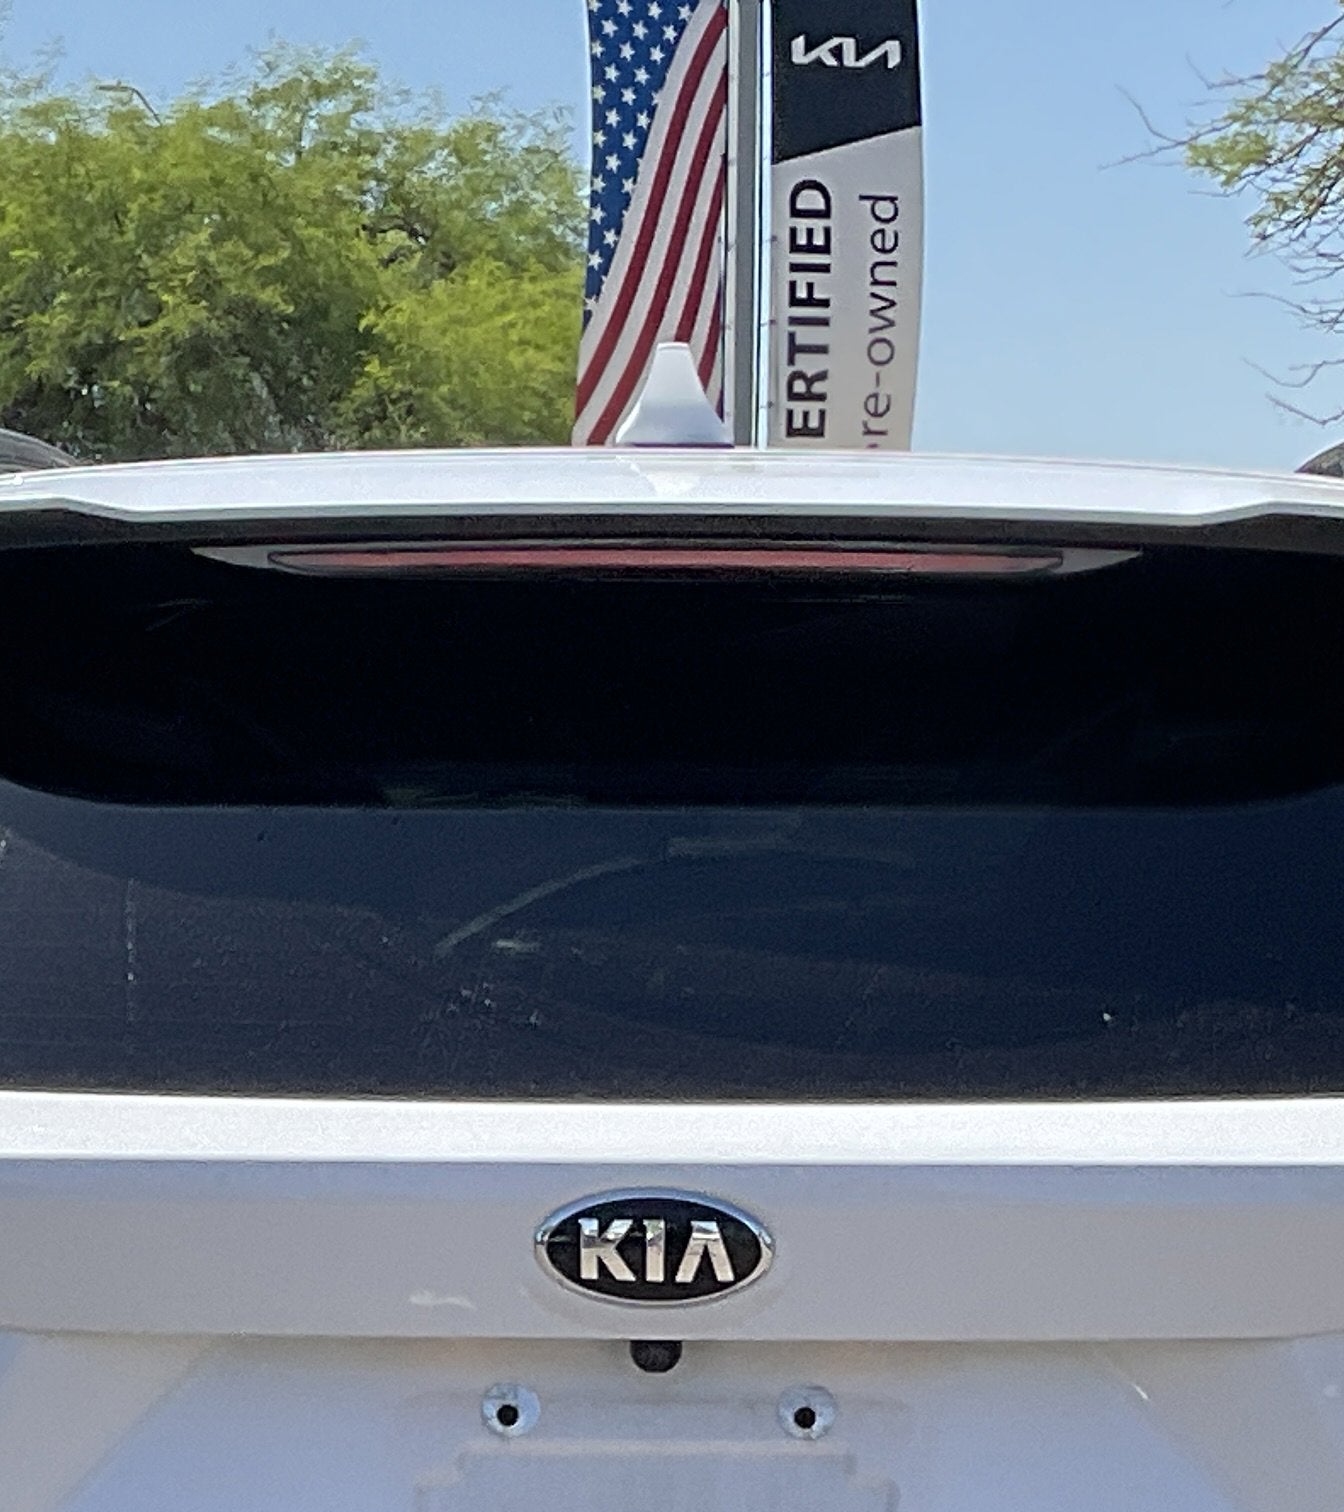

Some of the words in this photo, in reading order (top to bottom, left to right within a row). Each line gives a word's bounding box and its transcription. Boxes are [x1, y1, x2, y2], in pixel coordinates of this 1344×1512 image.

[790, 35, 902, 69] KIA
[786, 178, 833, 438] ERTIFIED
[859, 194, 900, 448] re-owned
[577, 1217, 736, 1284] KIA
